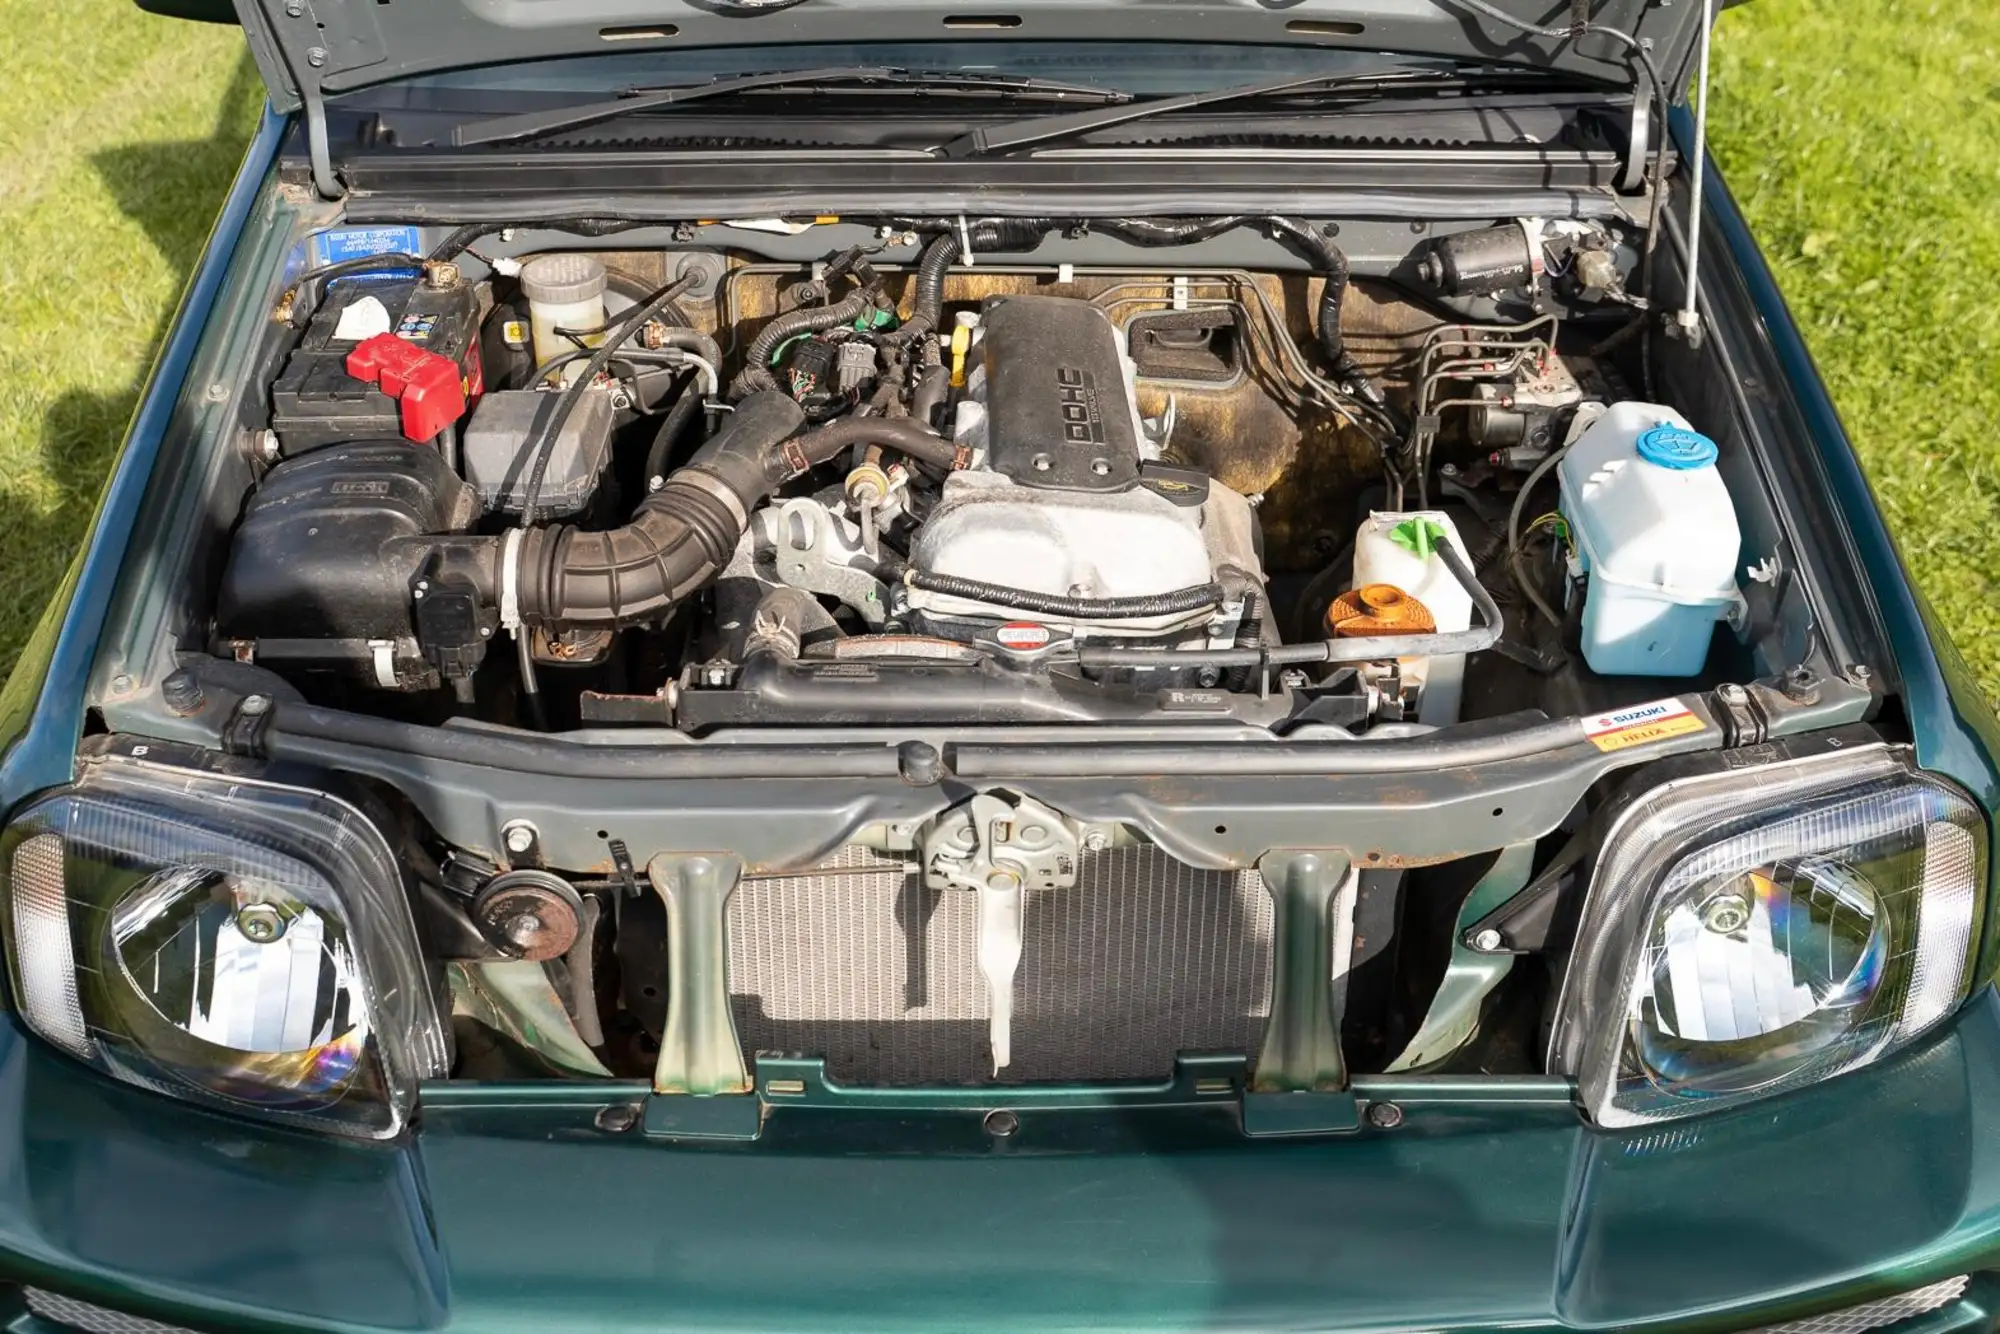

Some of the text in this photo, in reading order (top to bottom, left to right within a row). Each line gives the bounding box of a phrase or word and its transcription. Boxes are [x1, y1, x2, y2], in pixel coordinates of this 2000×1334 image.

[1056, 367, 1093, 444] DOHC
[1613, 706, 1667, 724] SUZUKI
[1622, 728, 1666, 743] HELIX
